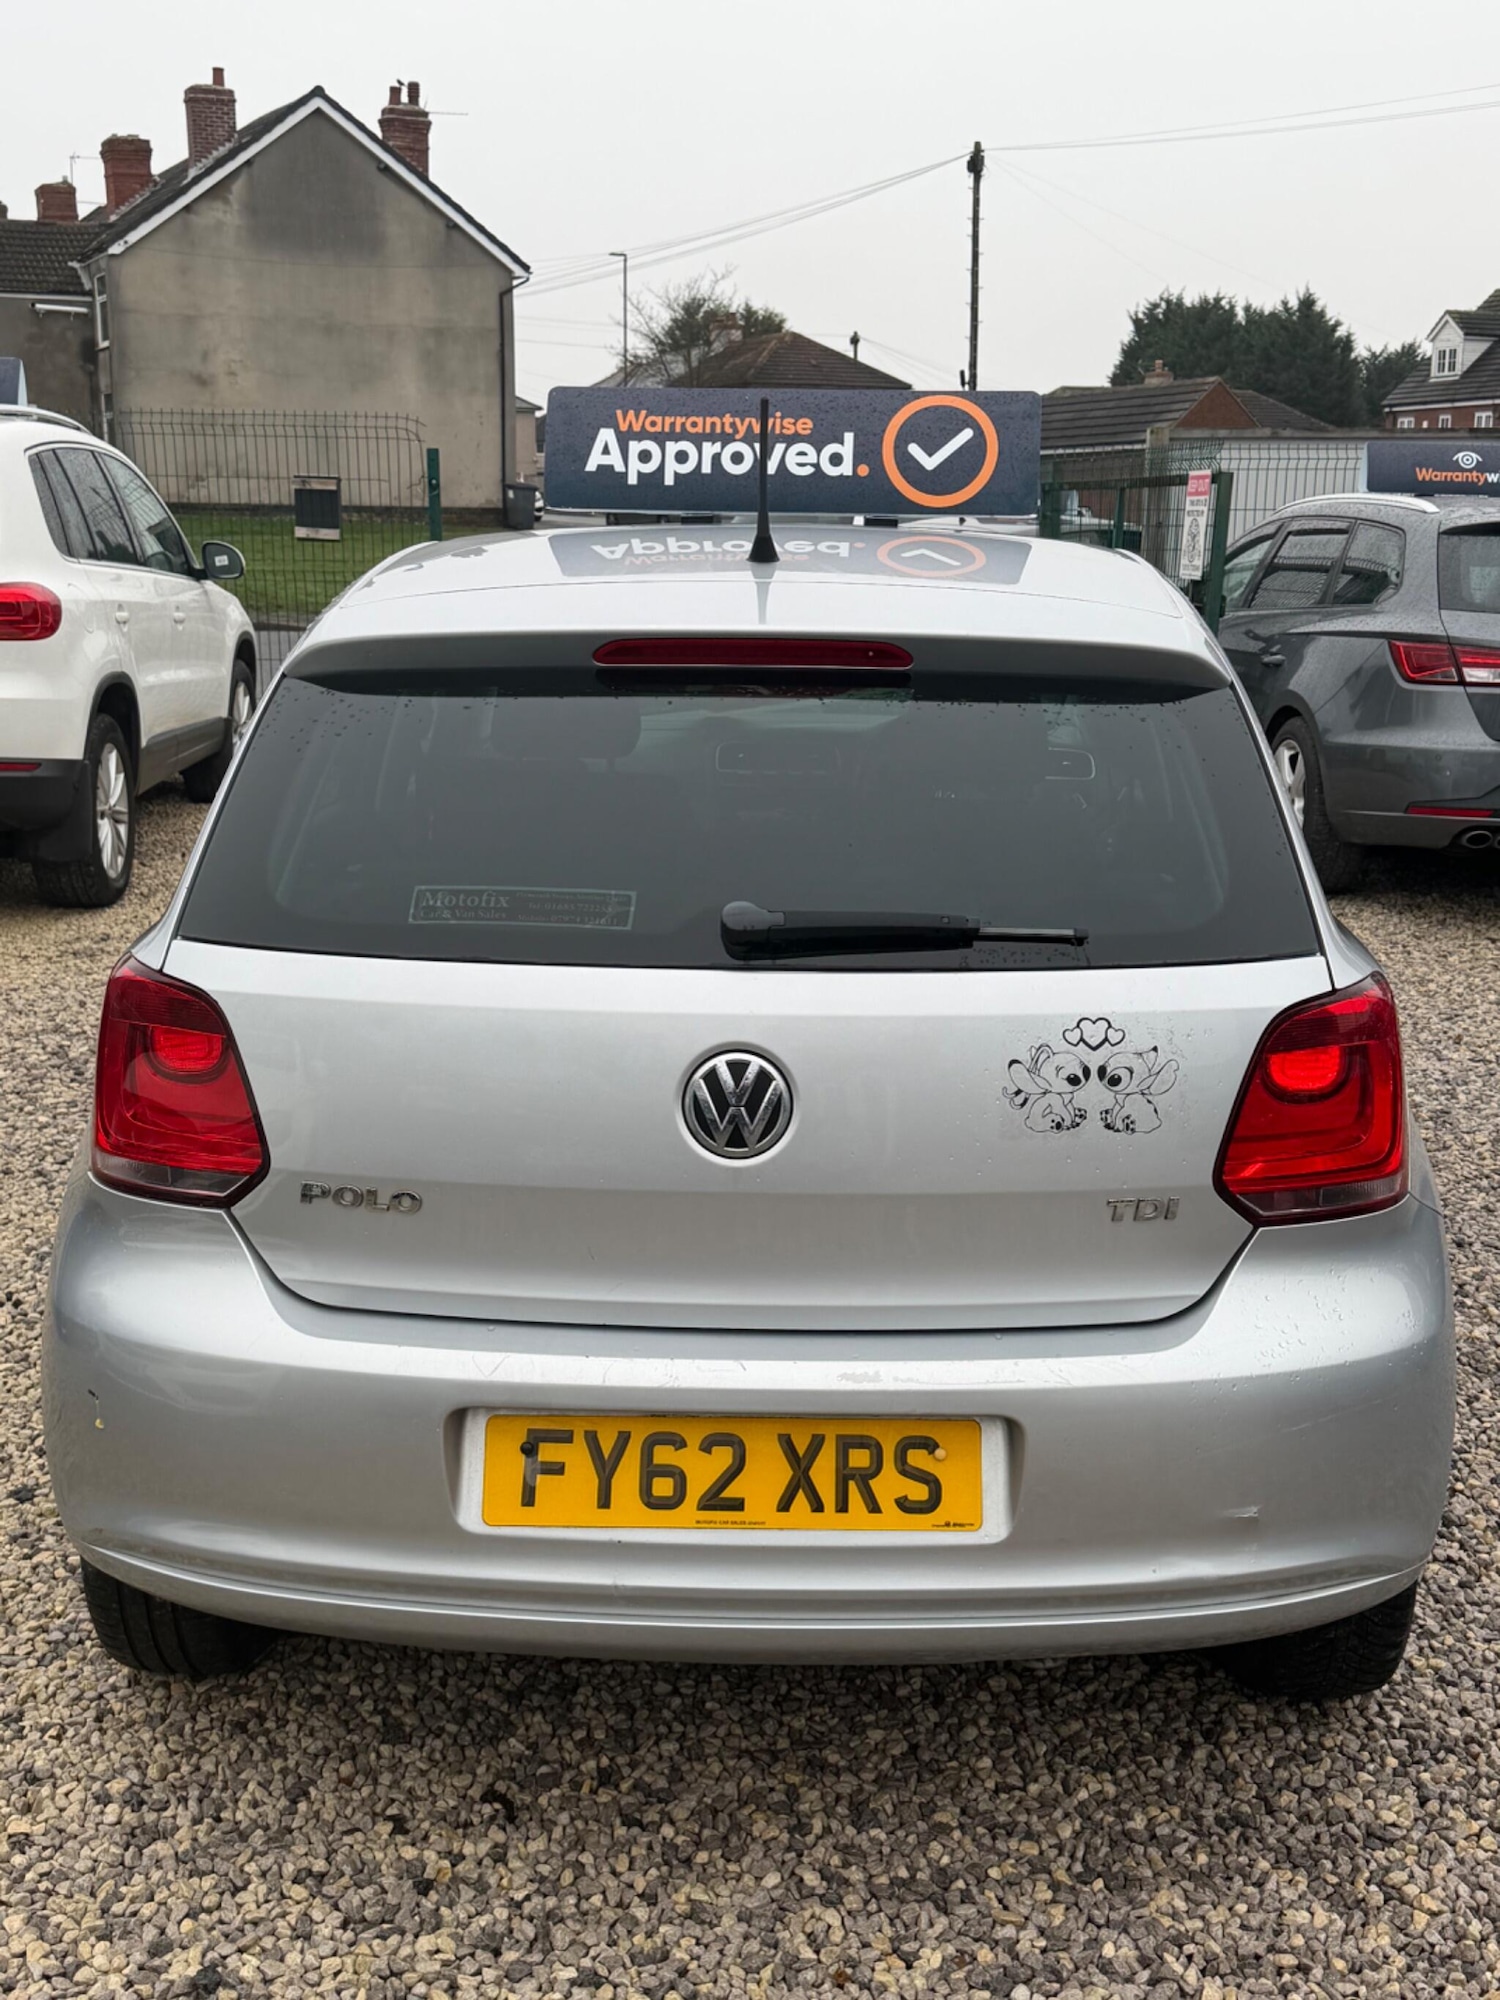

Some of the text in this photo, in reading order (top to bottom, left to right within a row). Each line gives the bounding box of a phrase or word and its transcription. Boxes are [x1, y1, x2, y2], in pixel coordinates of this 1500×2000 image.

[616, 409, 814, 440] Warrantywise
[584, 427, 870, 486] Approved.
[421, 891, 509, 908] Motofix
[300, 1180, 423, 1214] POLO
[1106, 1196, 1181, 1222] TDI
[520, 1428, 943, 1515] FY62 XRS
